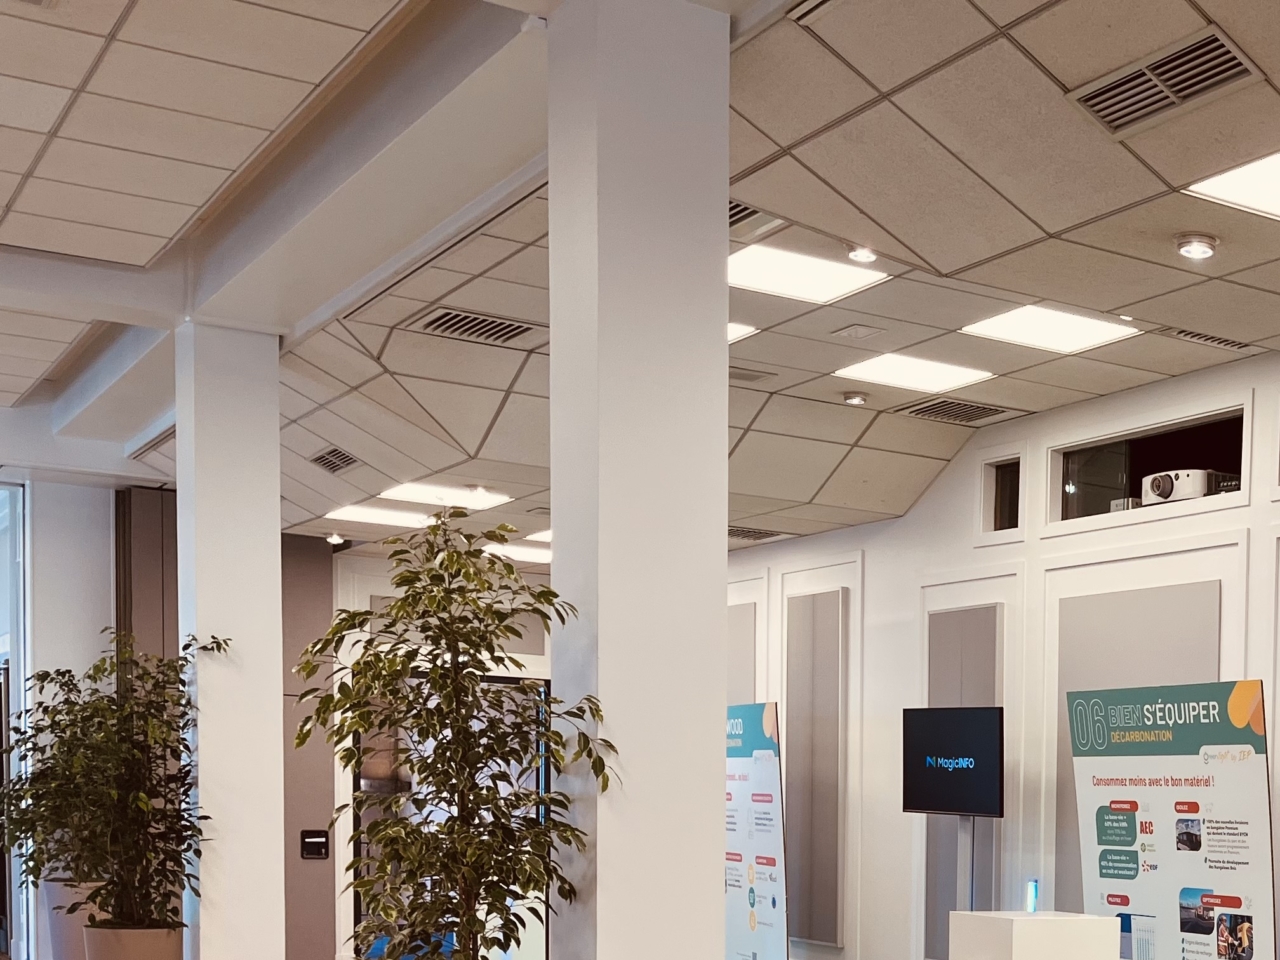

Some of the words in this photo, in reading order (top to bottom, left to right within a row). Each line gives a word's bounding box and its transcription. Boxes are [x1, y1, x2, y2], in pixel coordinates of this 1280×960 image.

[1073, 699, 1107, 750] 06
[1108, 705, 1142, 727] BIEN
[1144, 699, 1220, 727] S'ÉQUIPER
[1111, 730, 1173, 743] DÉCARBONATION
[938, 757, 974, 771] MagicINFO
[1092, 776, 1127, 786] Consommez
[1129, 776, 1146, 786] moins
[1148, 778, 1162, 787] avec
[1164, 776, 1169, 786] le
[1171, 776, 1182, 787] bon
[1184, 776, 1210, 787] matériel
[1140, 821, 1153, 834] AEC
